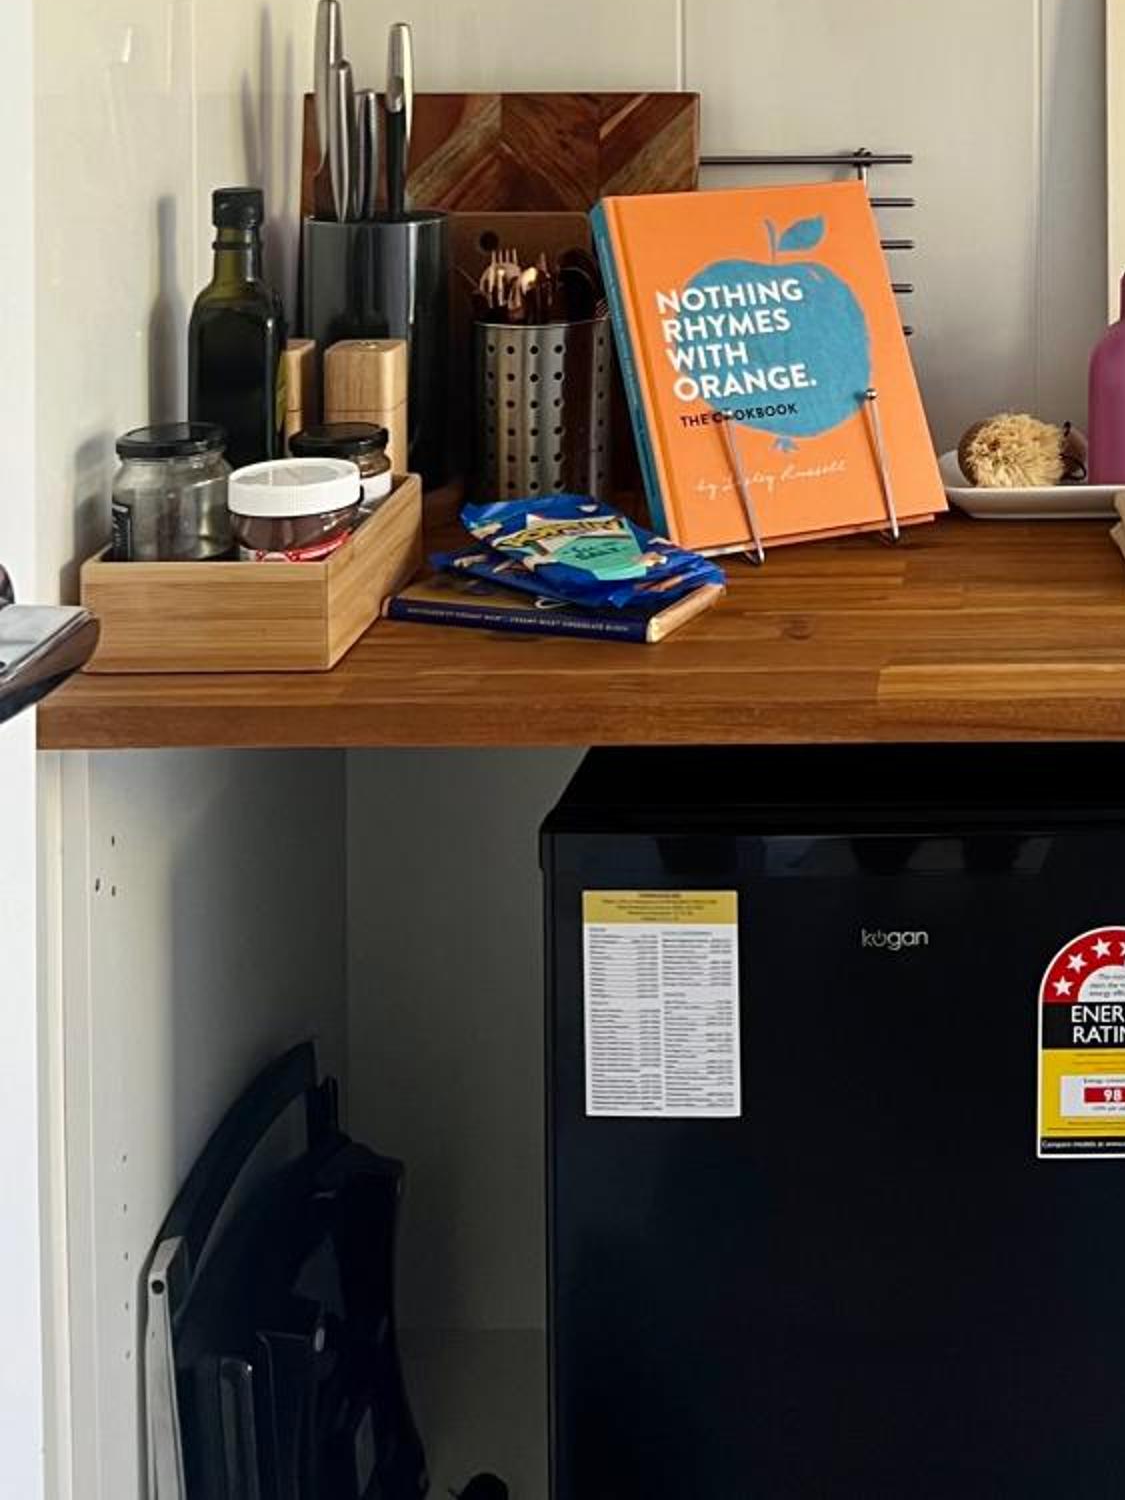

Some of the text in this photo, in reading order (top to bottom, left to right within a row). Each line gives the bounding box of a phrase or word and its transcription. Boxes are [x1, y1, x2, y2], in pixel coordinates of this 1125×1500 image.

[655, 278, 804, 315] NOTHING
[661, 308, 792, 343] RHYMES
[665, 341, 749, 373] WITH
[673, 363, 818, 402] ORANGE.
[680, 412, 710, 428] THE
[861, 928, 929, 951] kogan
[1103, 1088, 1123, 1102] 98
